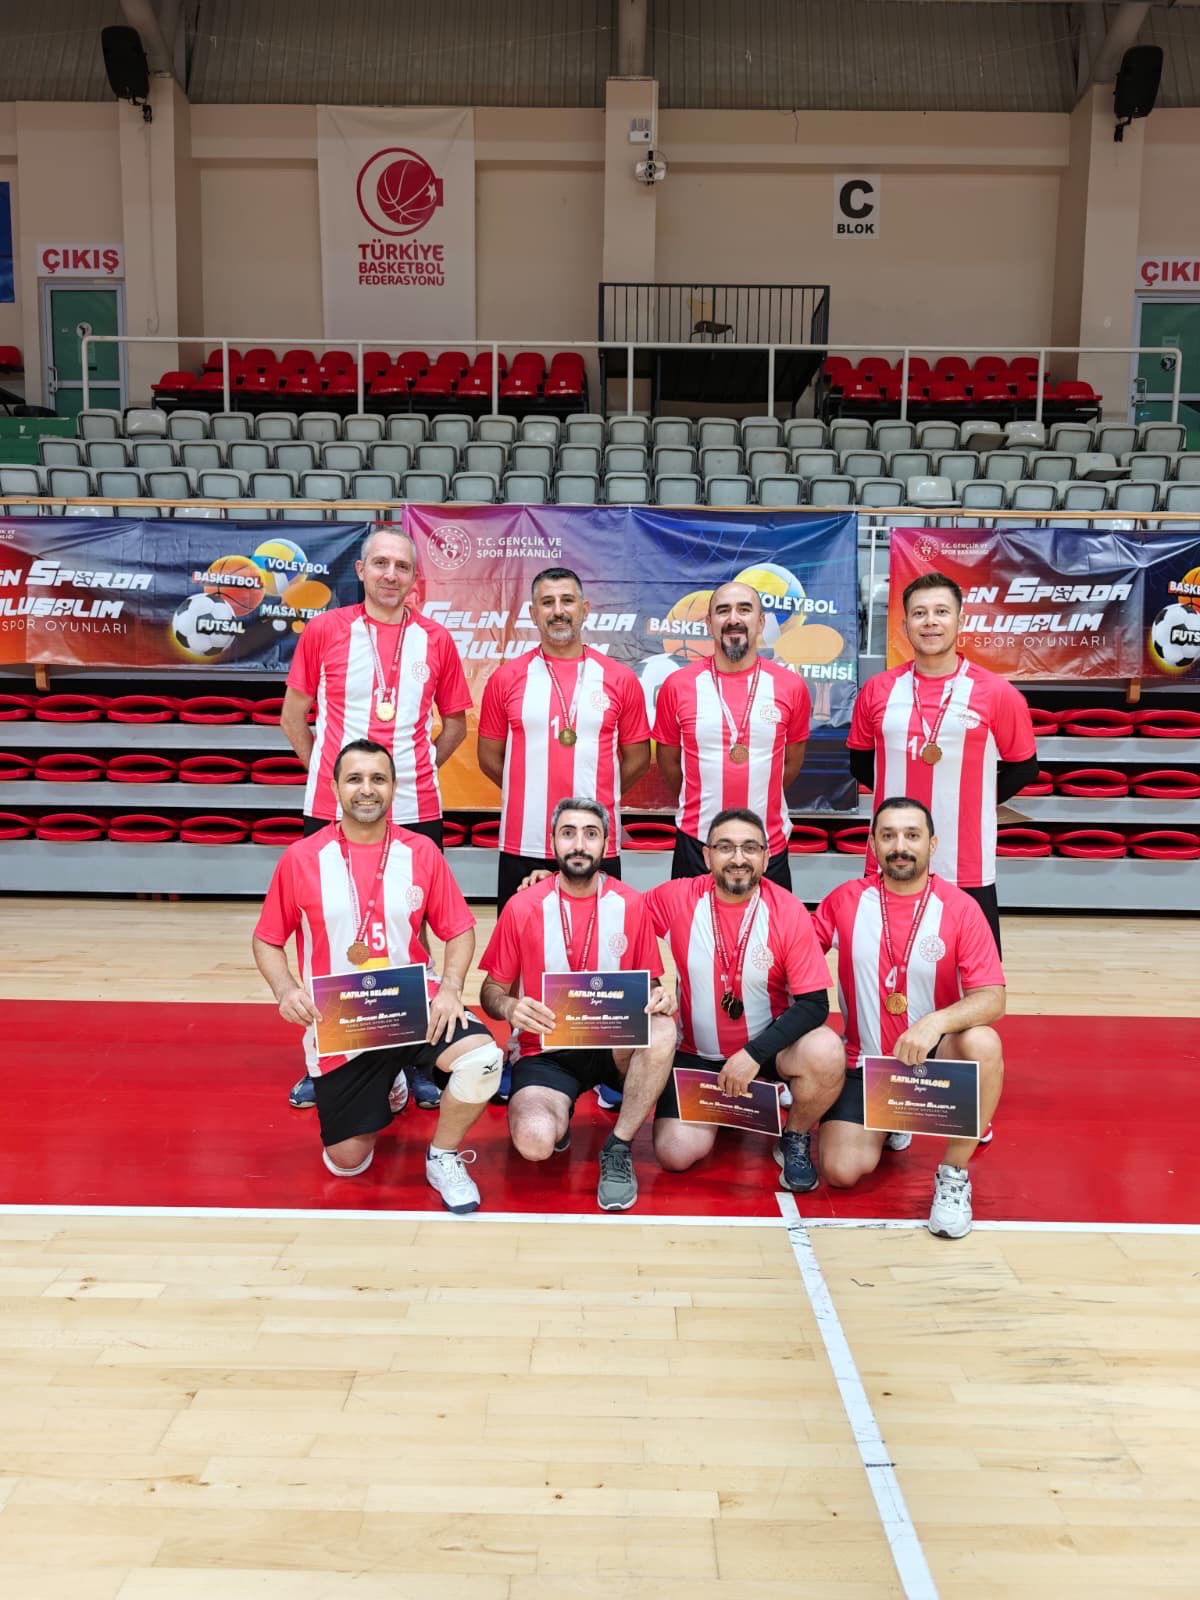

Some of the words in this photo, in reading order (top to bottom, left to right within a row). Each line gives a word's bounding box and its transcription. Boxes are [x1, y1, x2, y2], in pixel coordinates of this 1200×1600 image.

[839, 180, 874, 219] C
[837, 223, 875, 234] BLOK
[358, 239, 444, 261] TÜRKİYE
[42, 248, 119, 274] ÇIKIŞ
[358, 262, 445, 275] BASKETBOL
[359, 275, 445, 286] FEDERASYONU
[1141, 261, 1200, 287] ÇIKI
[476, 537, 496, 547] T.C.
[498, 535, 545, 548] GENÇLİK
[547, 537, 562, 547] VE
[476, 549, 503, 559] SPOR
[505, 547, 562, 559] BAKANLIĞI
[267, 558, 330, 575] VOLEYBOL
[194, 571, 261, 588] BASKETBOL
[1169, 580, 1200, 596] BASKE
[261, 604, 297, 618] MASA
[2, 619, 36, 632] SPOR
[45, 620, 127, 634] OYUNLARI
[197, 619, 246, 634] FUTSAL
[650, 617, 708, 636] BASKET
[974, 637, 1015, 648] SPOR
[1023, 635, 1107, 648] OYUNLARI
[1171, 629, 1200, 643] FUTS
[801, 662, 853, 681] TENİSİ
[371, 922, 386, 951] 5
